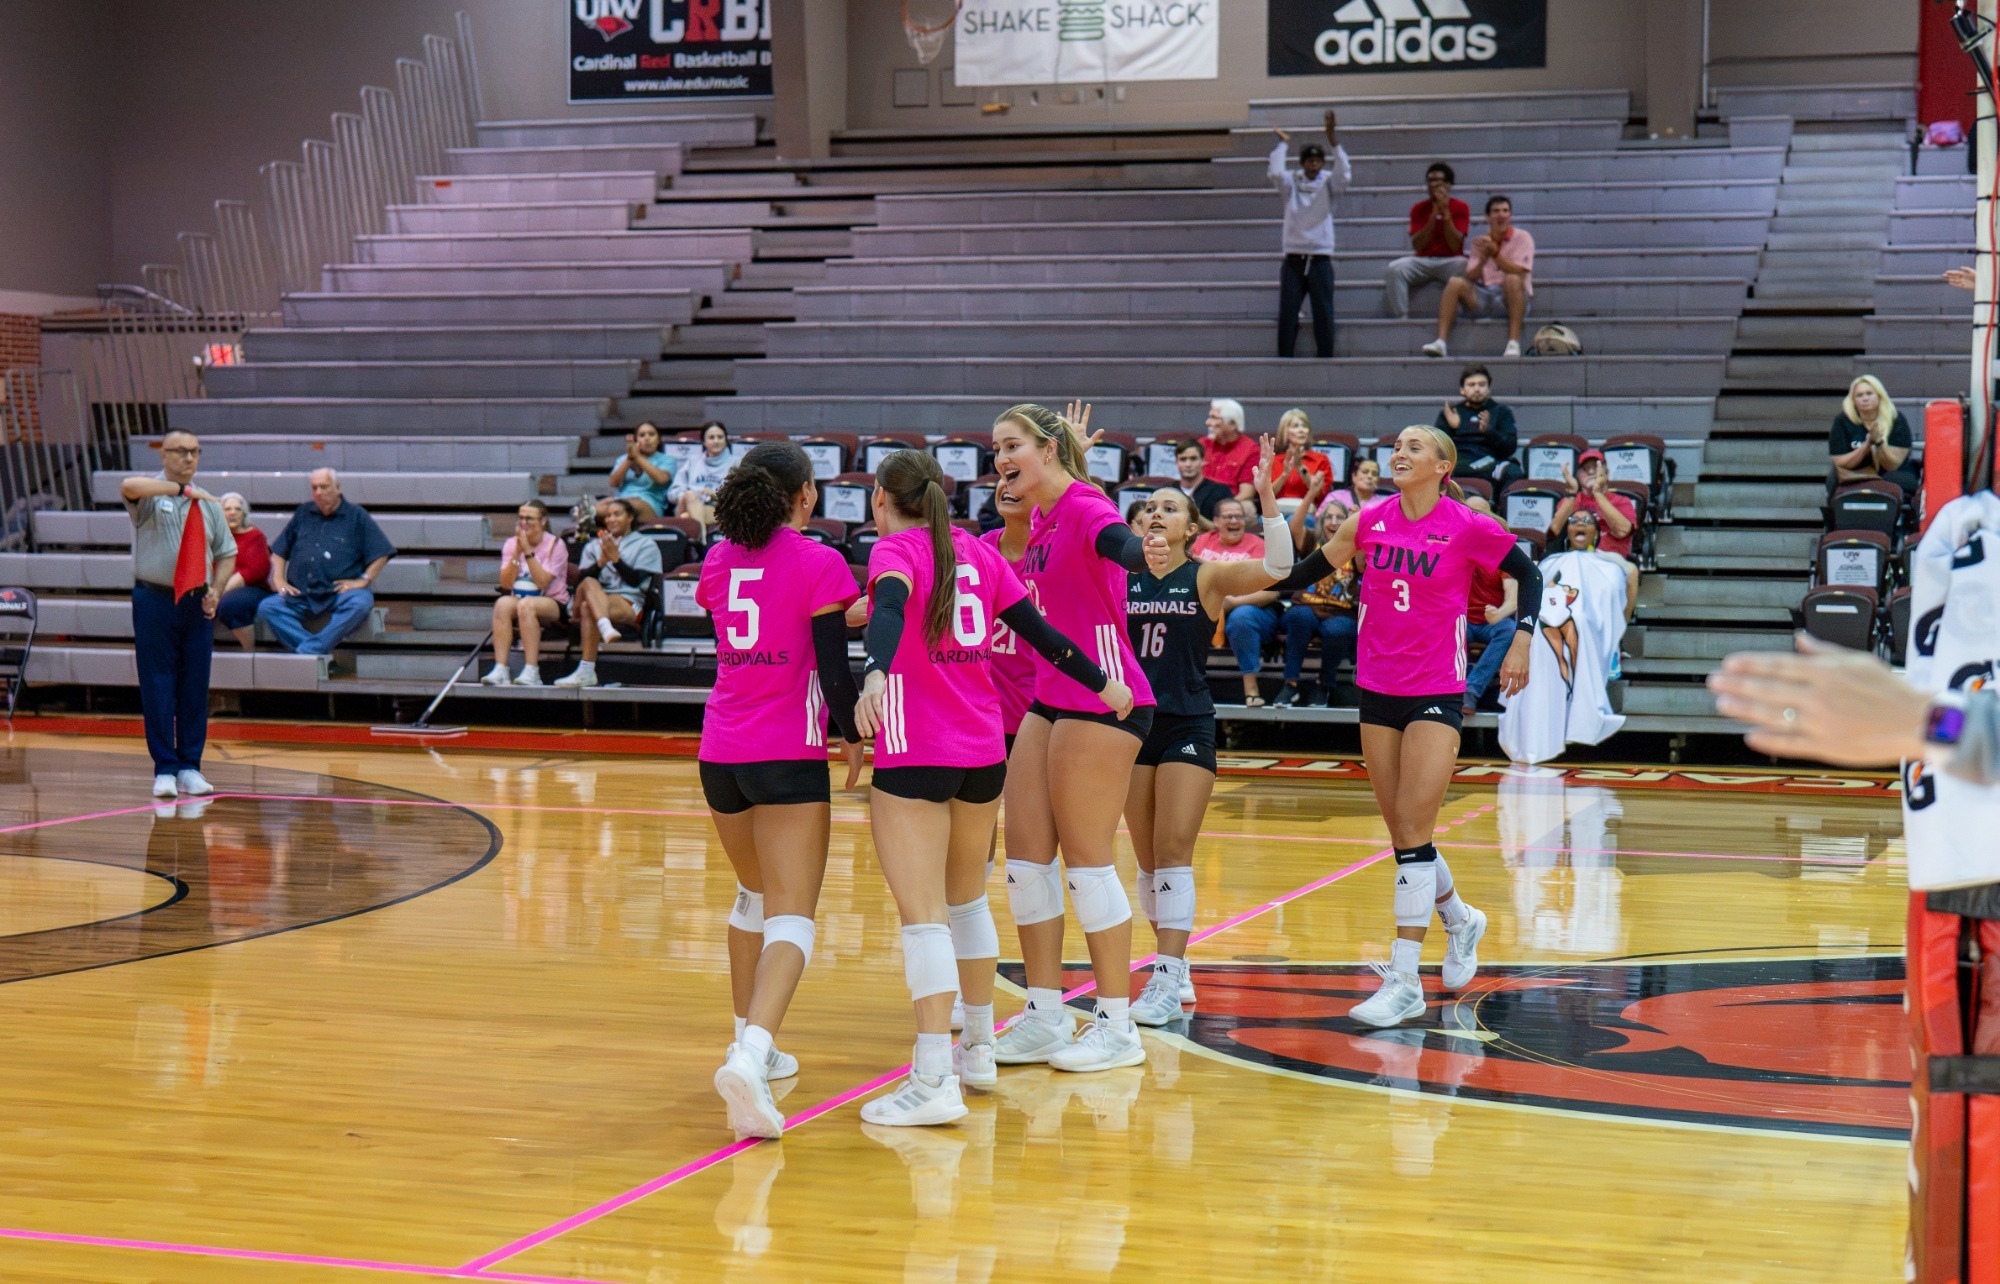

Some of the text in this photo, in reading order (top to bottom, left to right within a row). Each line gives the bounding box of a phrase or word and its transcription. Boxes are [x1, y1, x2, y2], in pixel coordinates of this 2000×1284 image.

[963, 3, 1205, 34] SHAKE SHACK
[1314, 16, 1498, 66] adidas
[573, 53, 637, 71] Cardinal
[640, 53, 671, 69] Red
[673, 50, 757, 69] Basketball
[1373, 544, 1440, 577] UIW
[727, 568, 764, 649] 5
[953, 564, 986, 646] 6
[1127, 600, 1198, 615] ARDINALS
[1392, 579, 1410, 612] 3
[991, 617, 1017, 655] 21
[1141, 622, 1167, 658] 16
